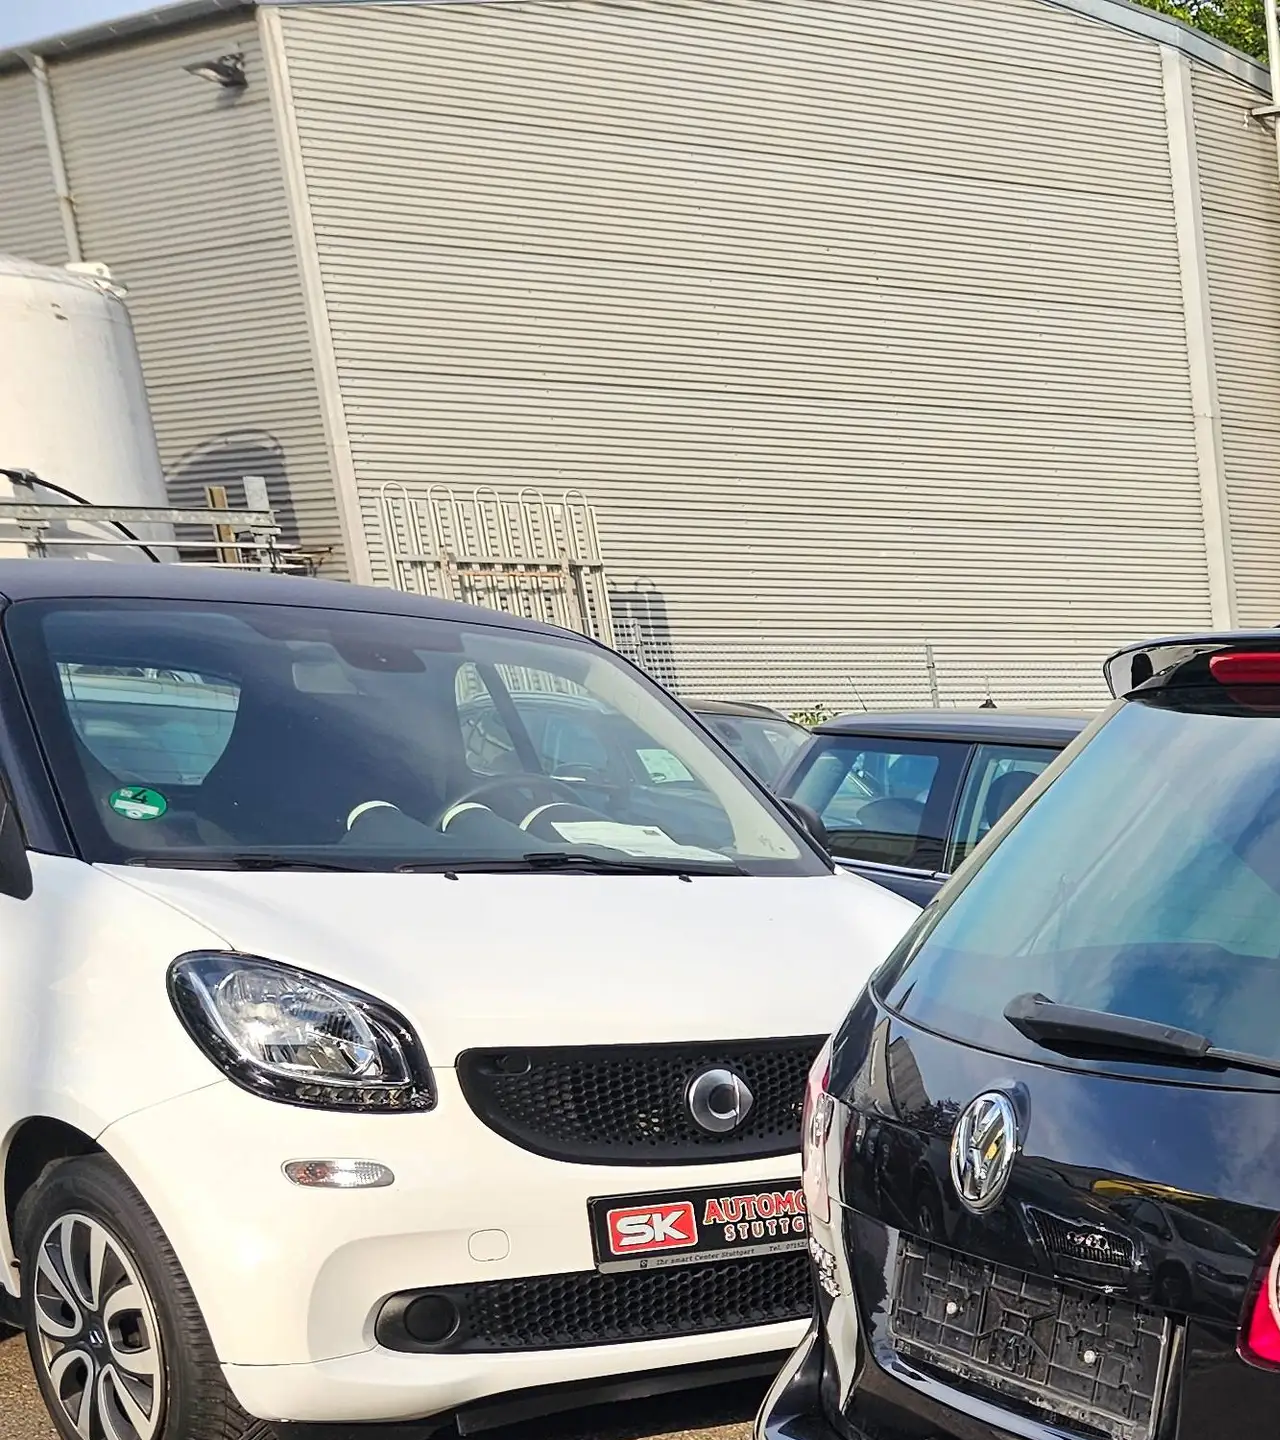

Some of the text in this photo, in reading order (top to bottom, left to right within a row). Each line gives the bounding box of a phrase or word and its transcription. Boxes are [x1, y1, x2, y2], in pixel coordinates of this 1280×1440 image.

[131, 789, 148, 804] 4
[616, 1209, 691, 1247] SK
[721, 1248, 755, 1259] Stuttgart
